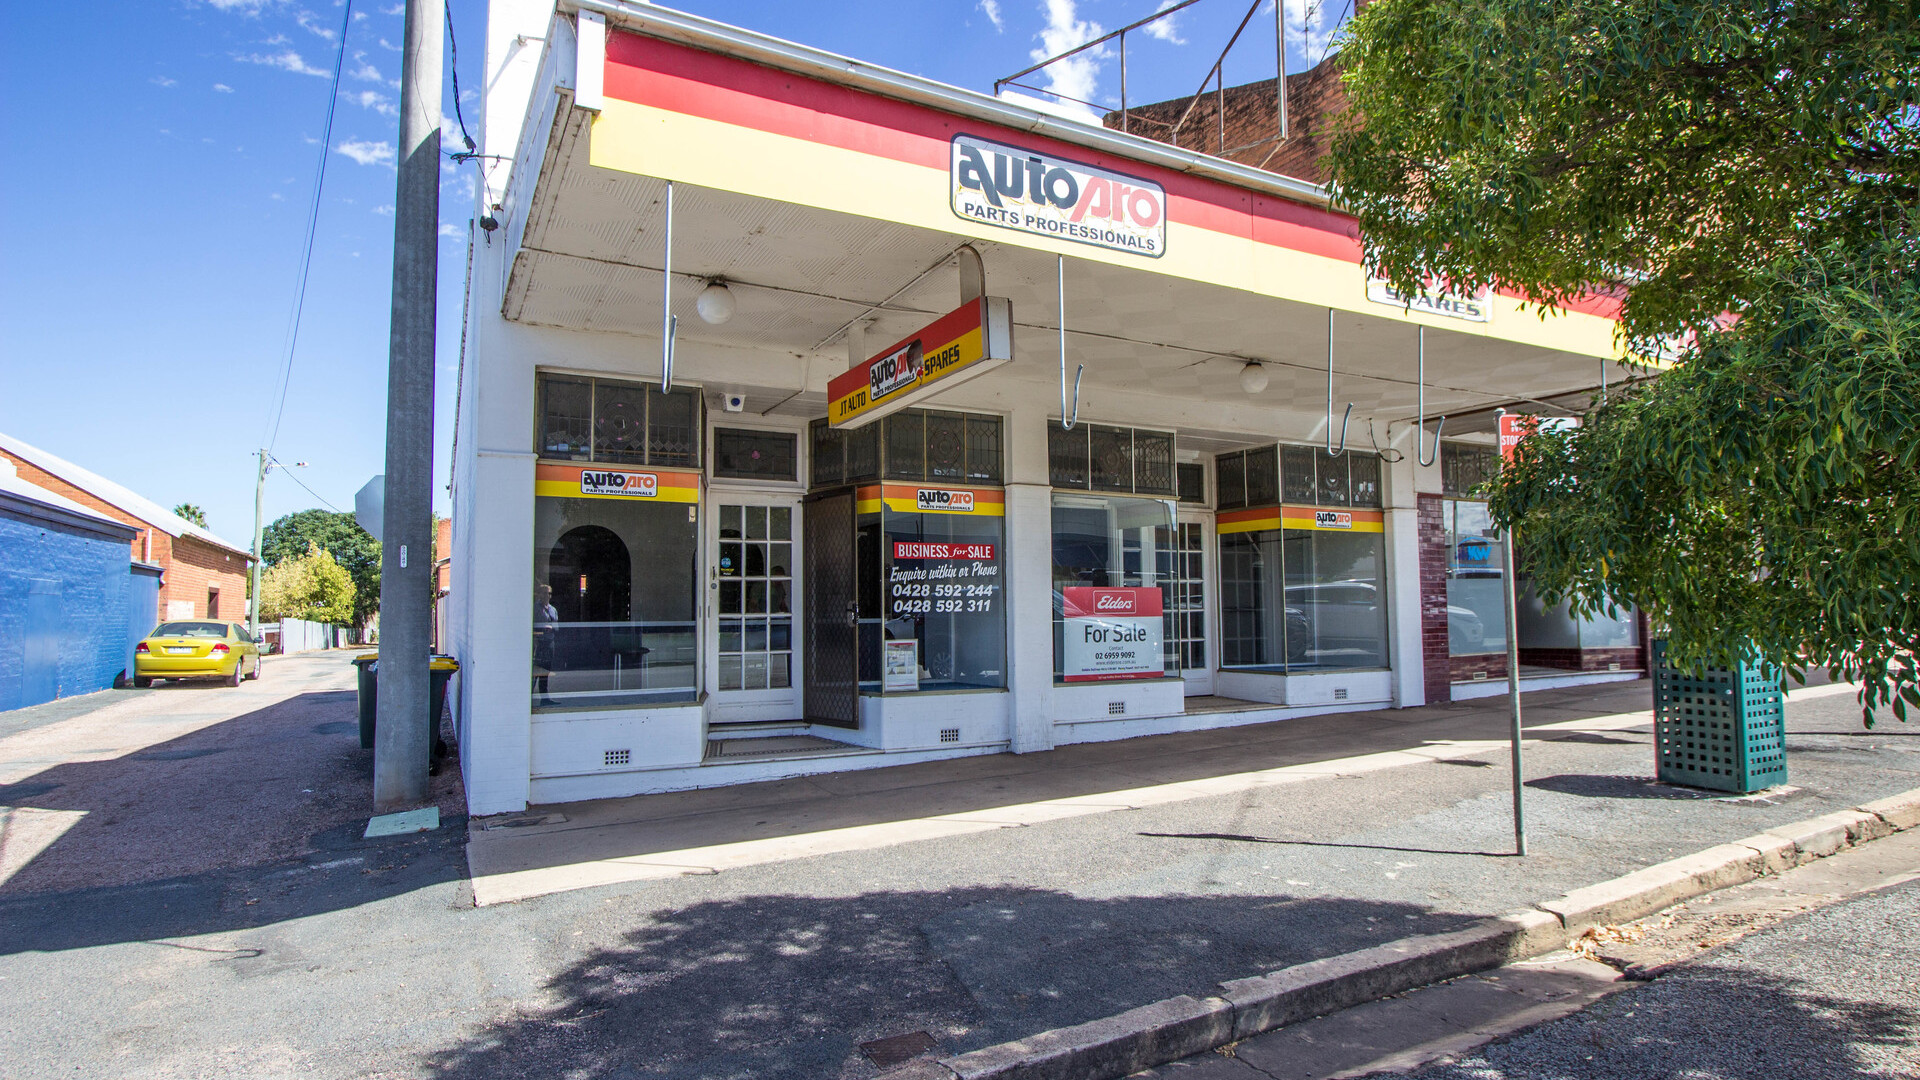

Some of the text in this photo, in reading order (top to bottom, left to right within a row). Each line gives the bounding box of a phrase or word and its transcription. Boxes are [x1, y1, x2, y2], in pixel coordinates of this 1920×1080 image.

[964, 202, 1155, 251] PARTS PROFESSIONALS
[1386, 286, 1480, 317] SARES
[924, 344, 960, 376] SPARES
[840, 391, 866, 416] JT AUTO
[898, 544, 991, 559] BUSINESS for SALE
[890, 561, 998, 585] Enquire within or Phone
[892, 584, 993, 597] 0428 592 244
[893, 600, 991, 613] 0428 592 311
[1097, 595, 1133, 609] Elders
[1084, 623, 1147, 643] For Sale
